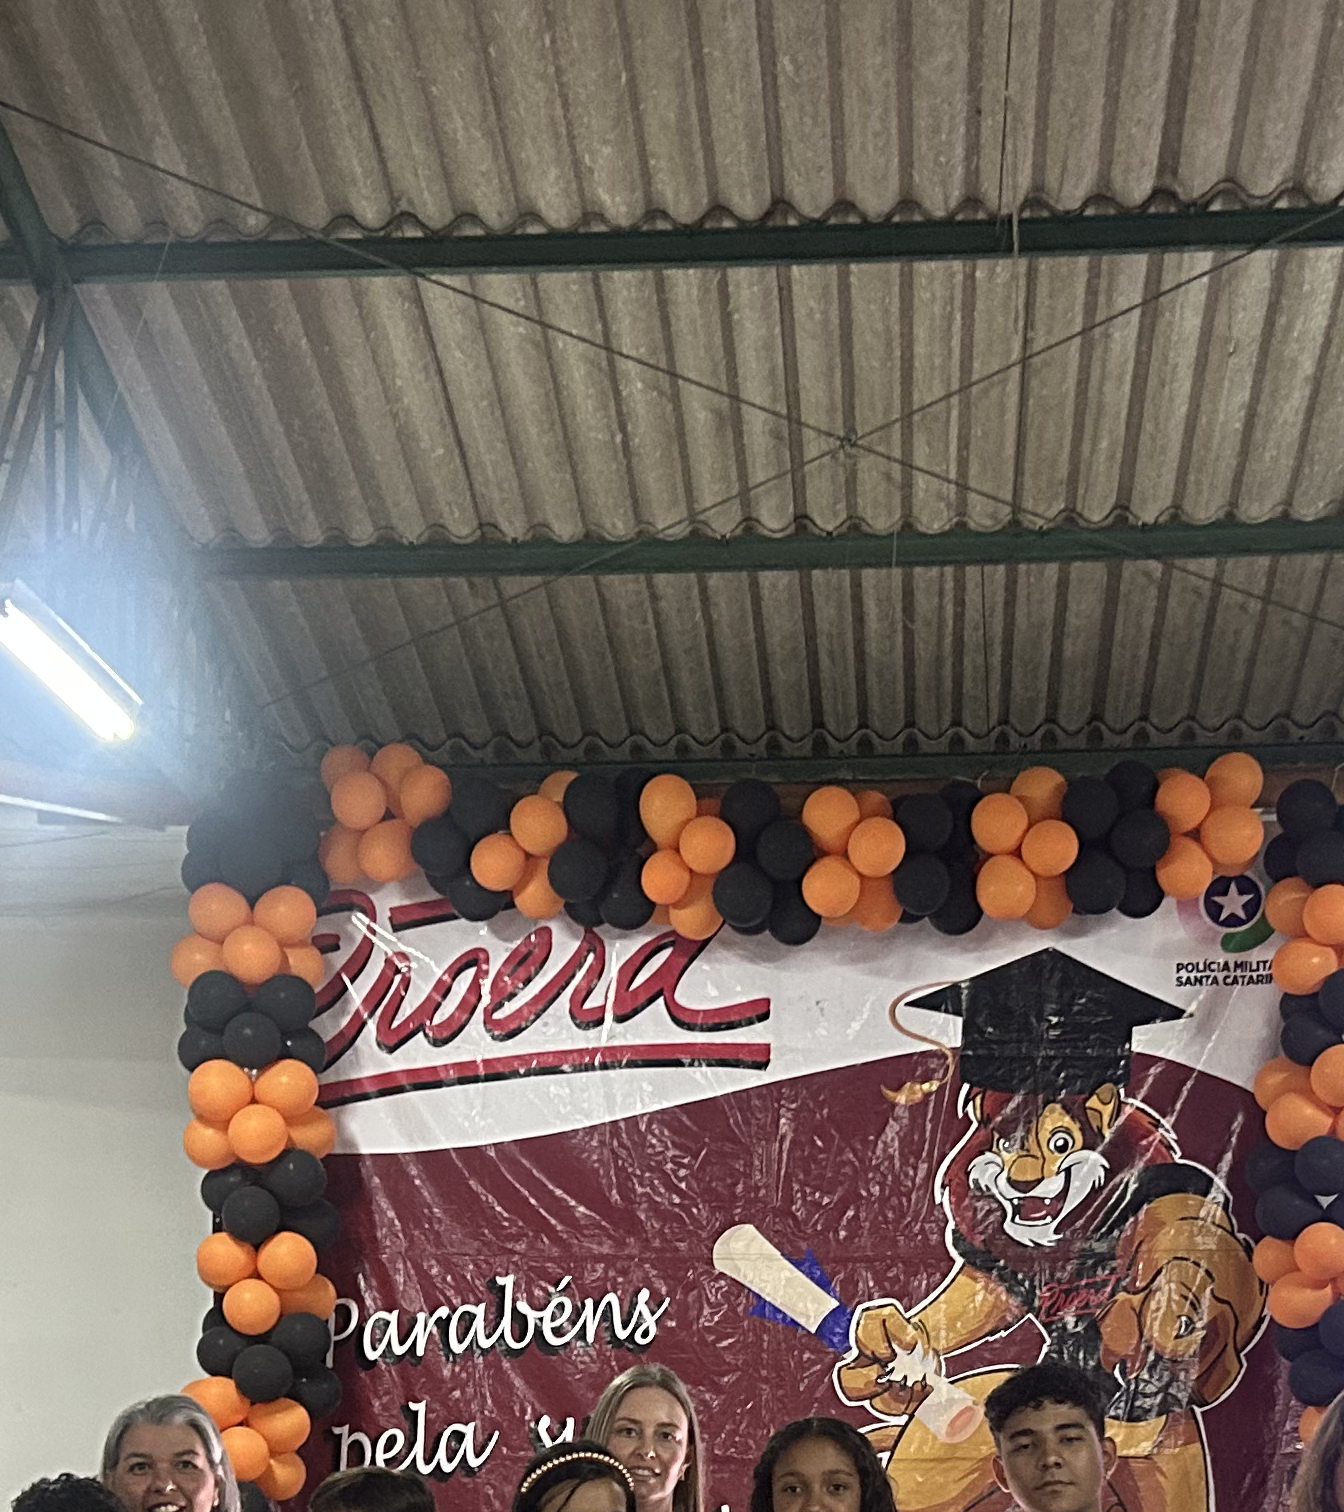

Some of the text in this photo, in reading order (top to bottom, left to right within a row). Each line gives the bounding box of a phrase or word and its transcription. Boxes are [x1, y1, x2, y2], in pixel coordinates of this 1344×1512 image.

[1175, 958, 1231, 973] POLÍCIA
[1175, 975, 1219, 987] SANTA
[332, 1400, 500, 1475] pela
